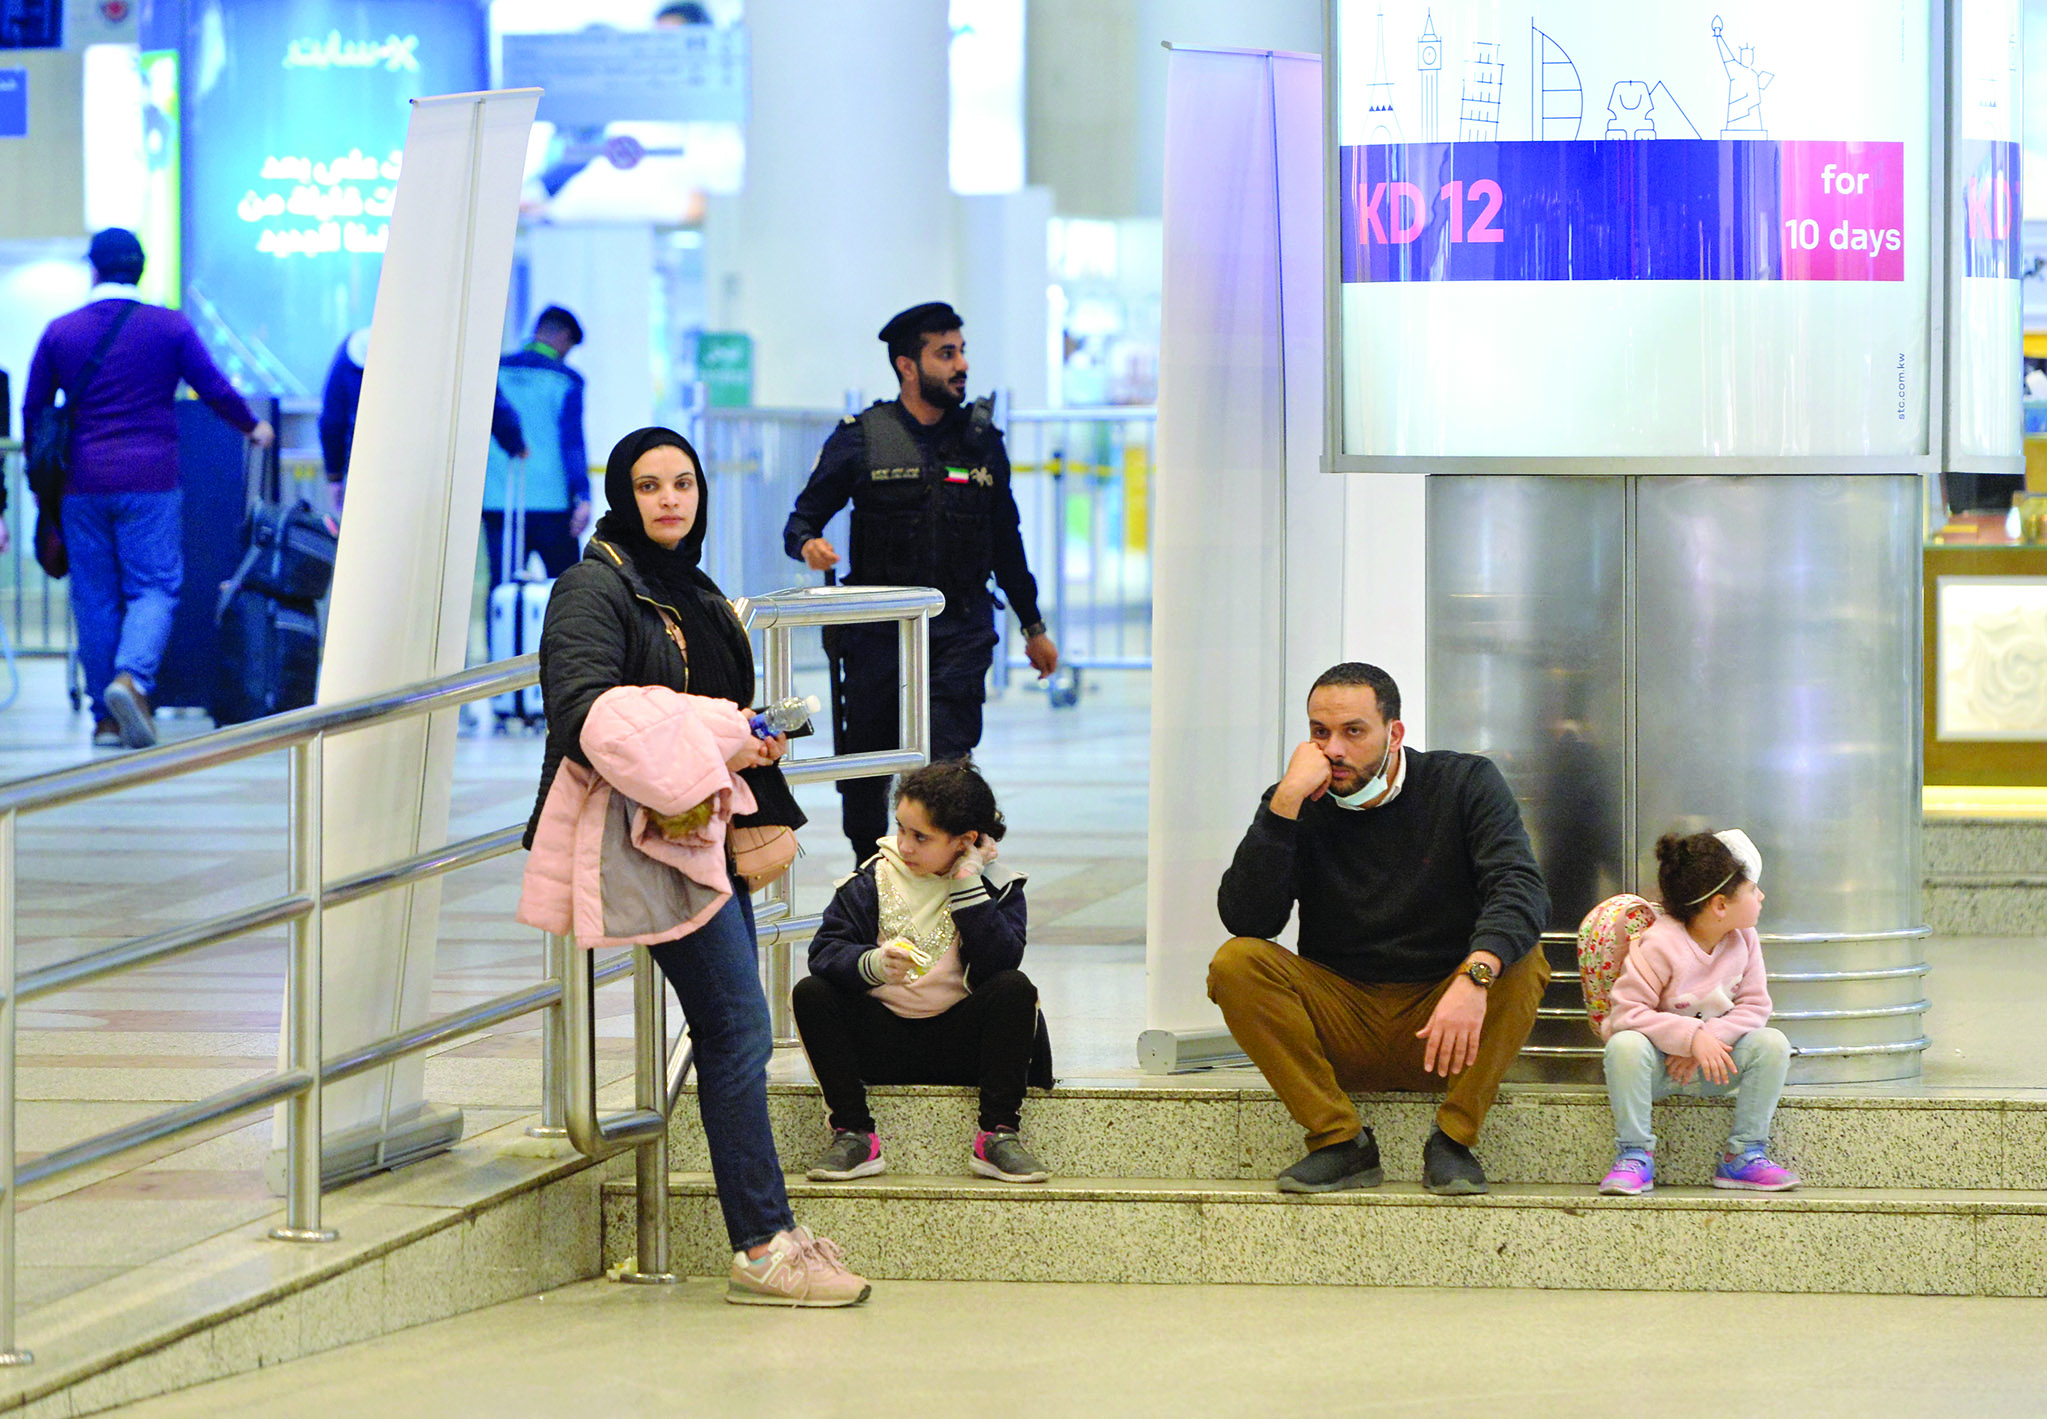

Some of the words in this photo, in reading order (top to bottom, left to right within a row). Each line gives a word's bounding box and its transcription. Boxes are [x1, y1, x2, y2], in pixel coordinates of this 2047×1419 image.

[1821, 164, 1869, 195] for
[1969, 177, 2012, 240] KD
[1359, 182, 1426, 244] KD
[1441, 179, 1504, 243] 12
[1785, 219, 1819, 250] 10
[1829, 220, 1901, 258] days
[1896, 353, 1905, 420] stc.com.kw
